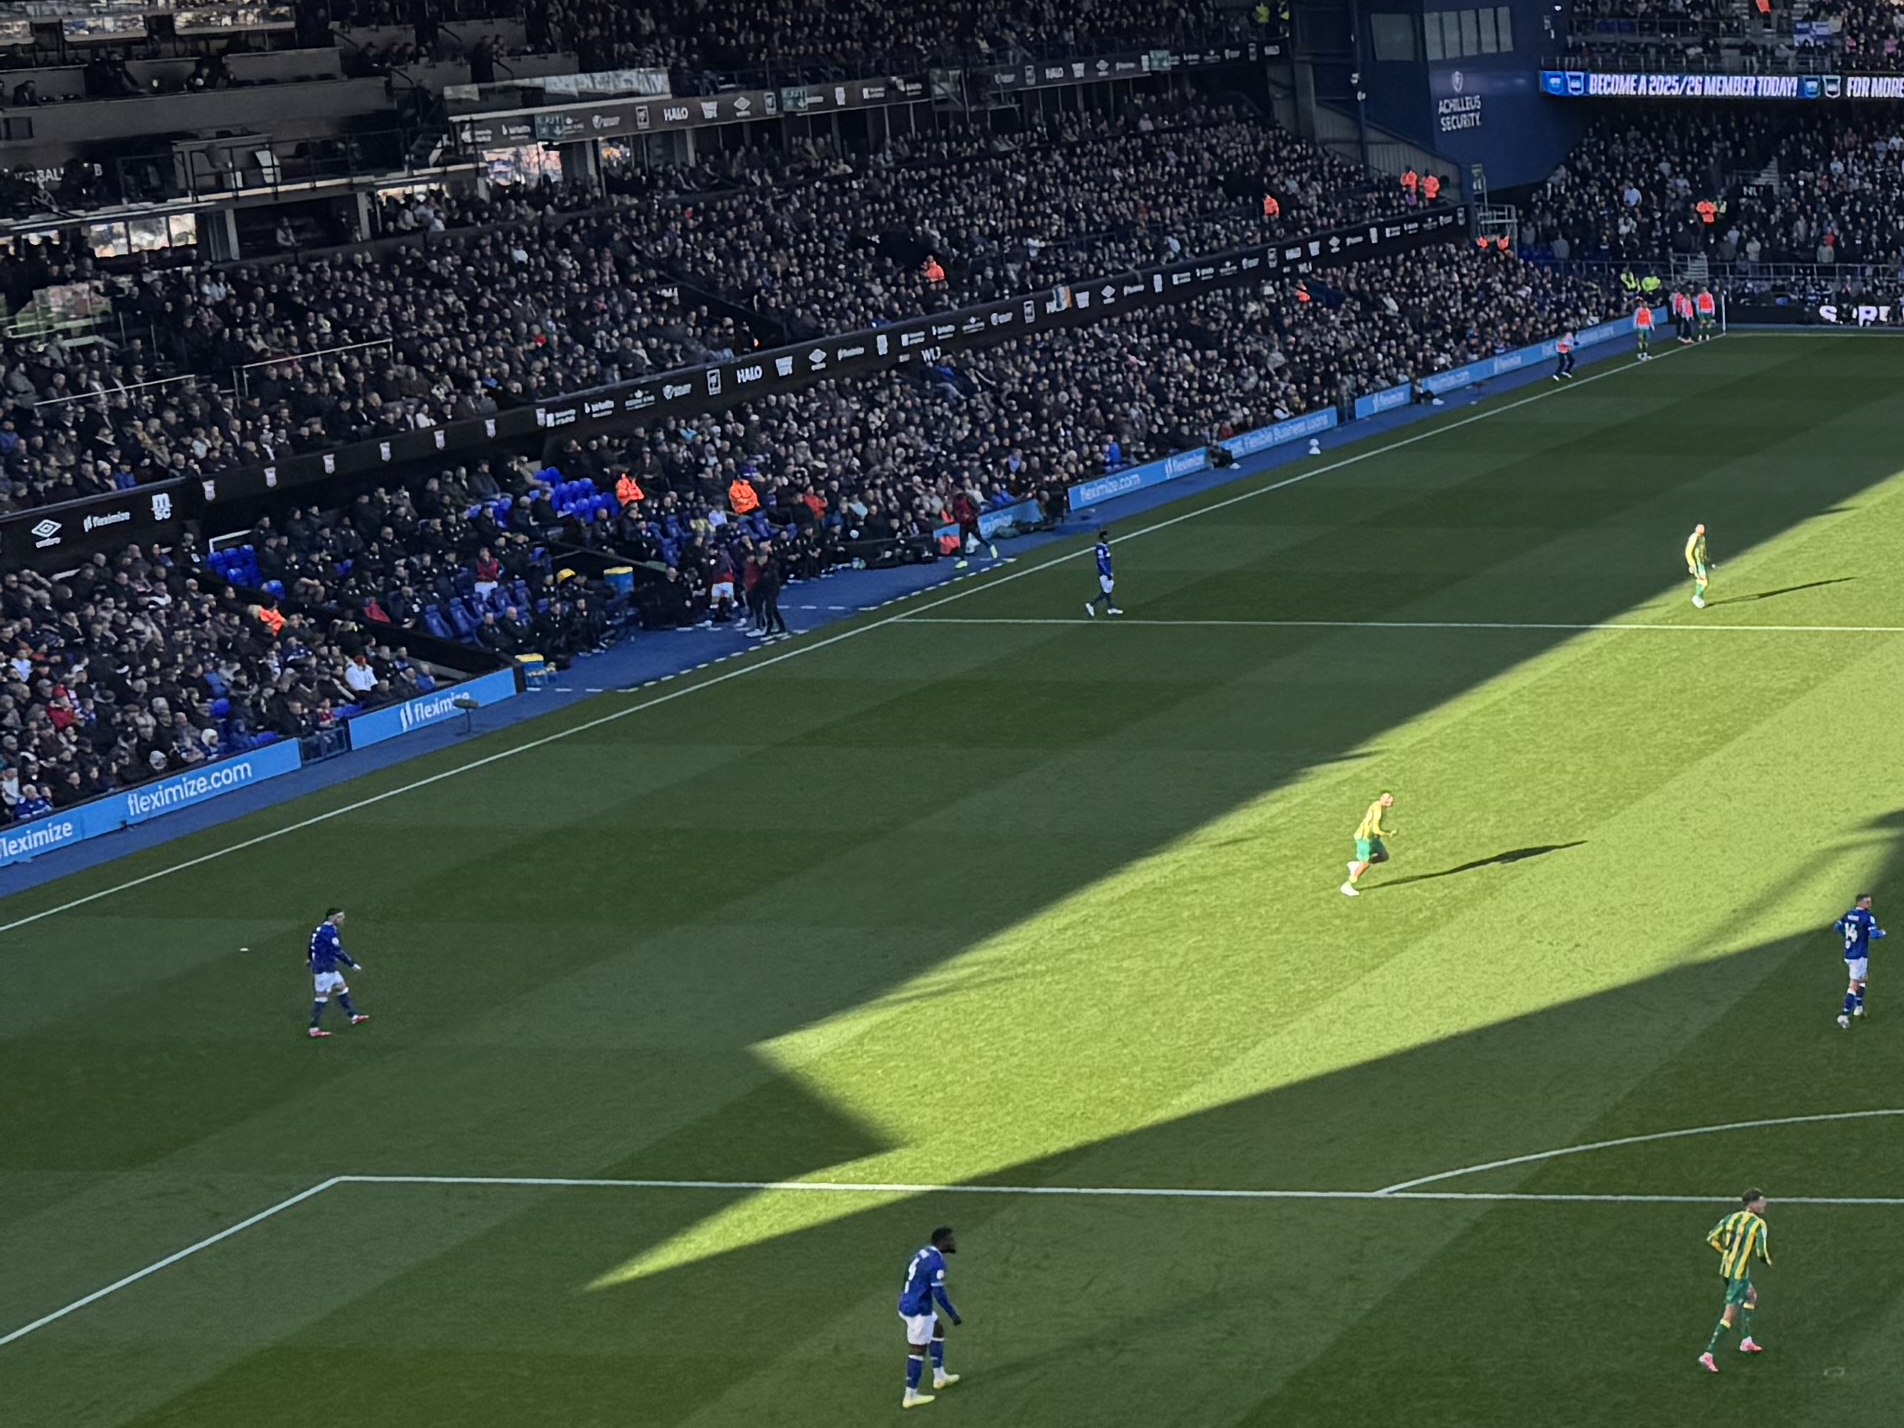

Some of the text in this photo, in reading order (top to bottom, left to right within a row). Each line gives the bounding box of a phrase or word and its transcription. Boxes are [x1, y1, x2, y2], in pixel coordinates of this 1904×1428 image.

[1589, 74, 1798, 97] BECOME A 2025/26 MEMBER TODAY!
[1847, 77, 1871, 97] FOR
[1871, 78, 1904, 98] MORE
[1440, 112, 1482, 132] SECURITY
[736, 365, 763, 384] HALO
[127, 760, 253, 817] fleximize.com
